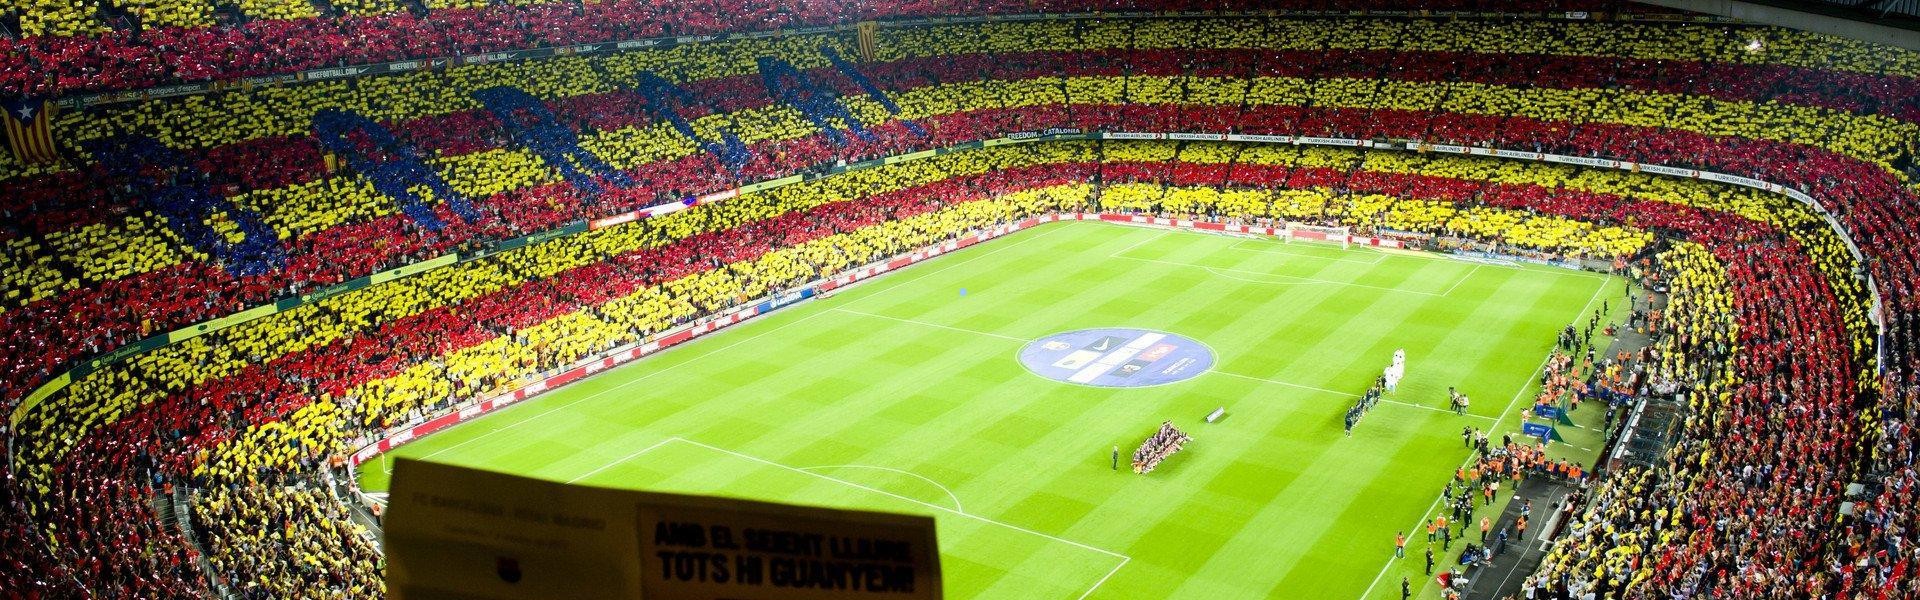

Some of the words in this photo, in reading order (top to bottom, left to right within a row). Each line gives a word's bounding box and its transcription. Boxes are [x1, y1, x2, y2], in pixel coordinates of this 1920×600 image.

[308, 67, 358, 79] NIKEFOOTBALL.COM
[1007, 131, 1038, 140] FREEDOM
[1043, 128, 1081, 136] CATALONIA
[1714, 174, 1739, 183] TURKISH
[1738, 178, 1763, 188] AIRLINES
[655, 521, 706, 548] AMB
[709, 524, 739, 551] EL
[742, 527, 825, 557] SEIENT
[657, 550, 731, 584] TOTS
[735, 555, 764, 585] HI
